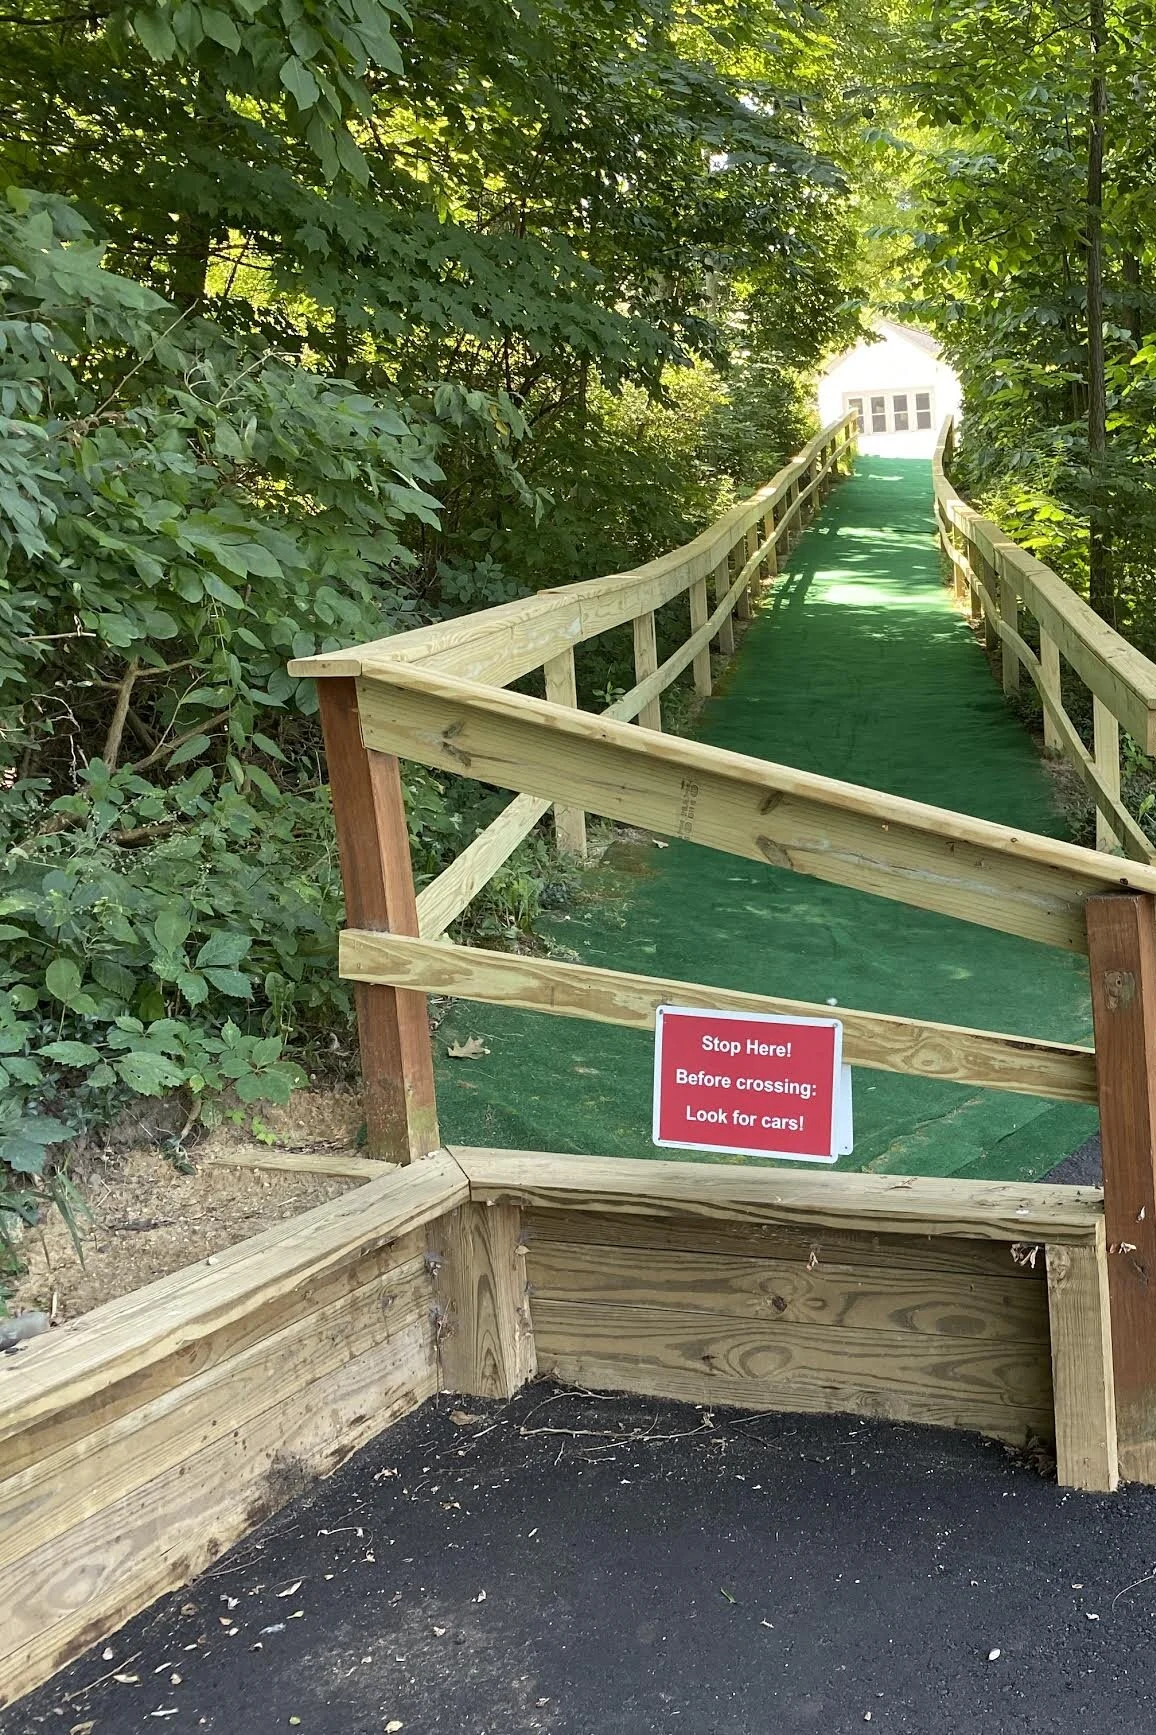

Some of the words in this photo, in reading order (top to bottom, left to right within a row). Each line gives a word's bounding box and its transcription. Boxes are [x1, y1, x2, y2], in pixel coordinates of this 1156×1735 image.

[702, 1035, 741, 1056] Stop
[747, 1039, 791, 1057] Here!
[675, 1069, 731, 1088] Before
[736, 1078, 817, 1099] crossing:
[686, 1105, 728, 1124] Look
[732, 1110, 757, 1126] for
[761, 1116, 804, 1131] cars!
